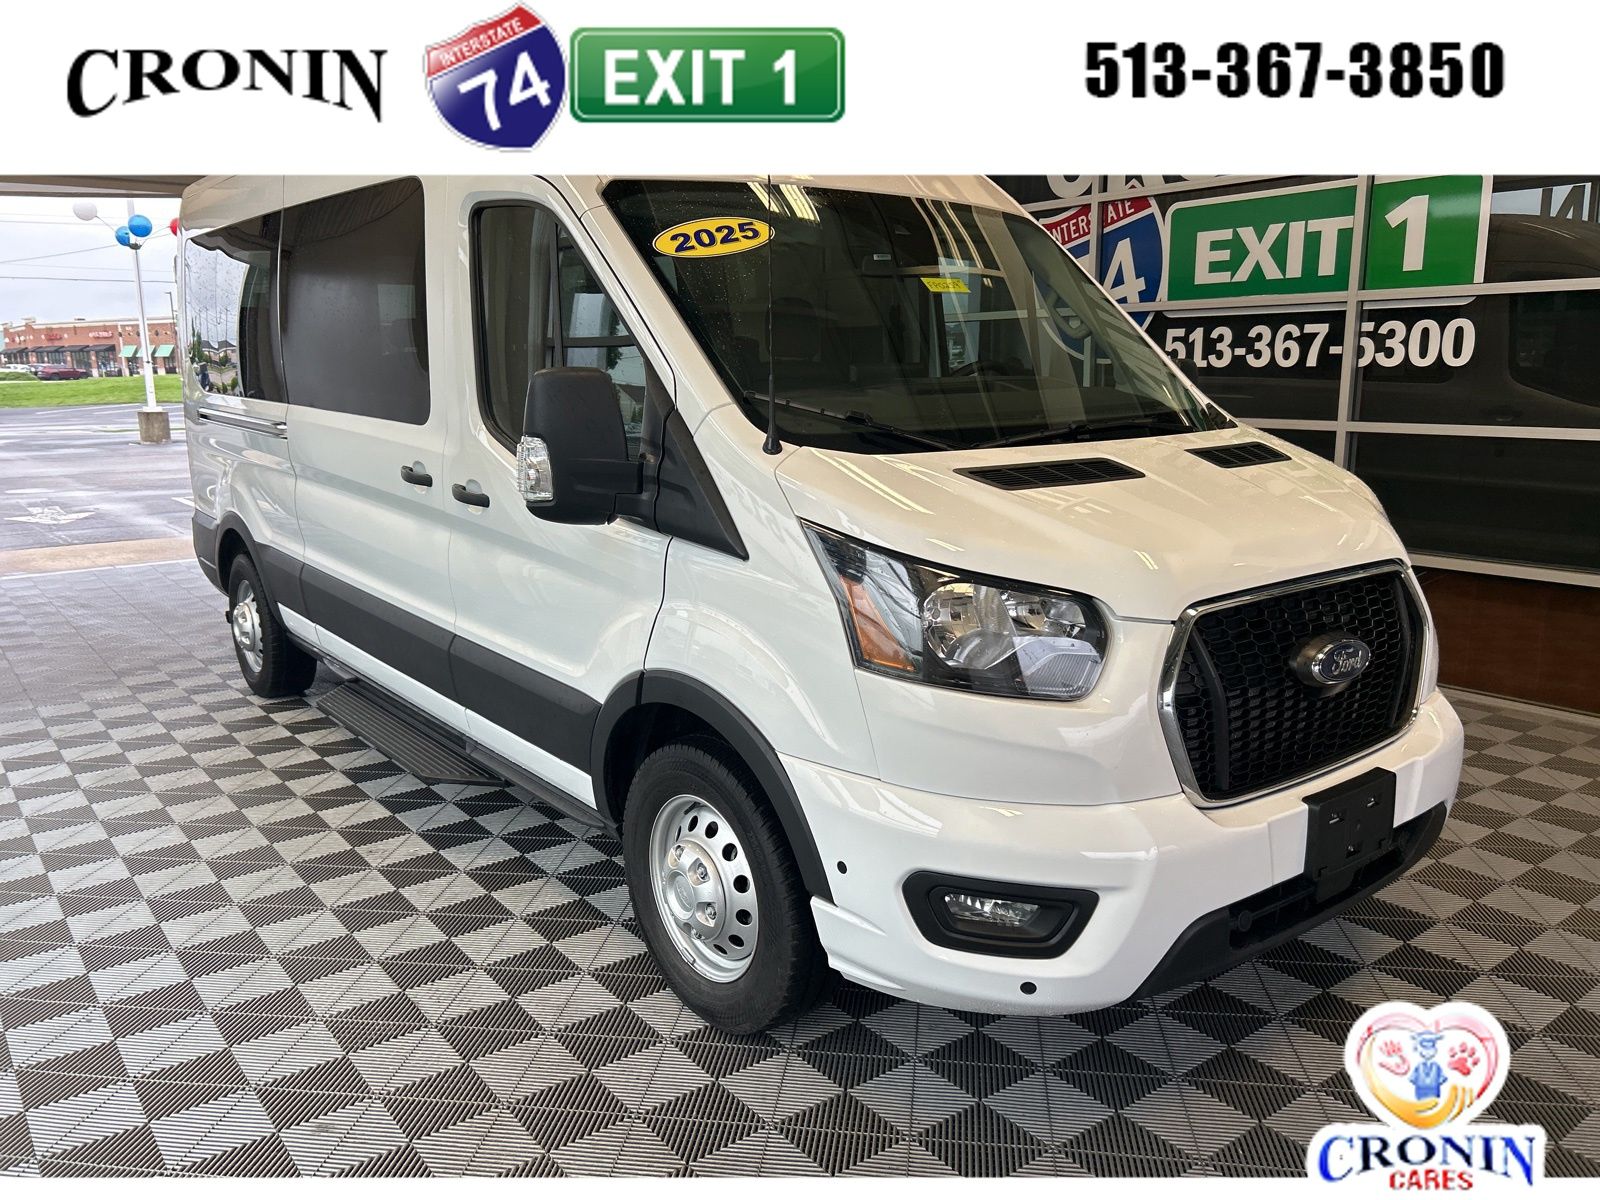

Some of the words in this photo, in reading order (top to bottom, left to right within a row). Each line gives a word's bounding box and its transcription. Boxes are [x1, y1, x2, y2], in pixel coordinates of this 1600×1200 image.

[669, 221, 761, 253] 2025
[1050, 199, 1135, 245] NTERATE
[1193, 215, 1355, 286] EXIT
[1384, 194, 1430, 272] 1
[1164, 317, 1476, 368] 513-367-5300
[1331, 646, 1362, 676] Ford
